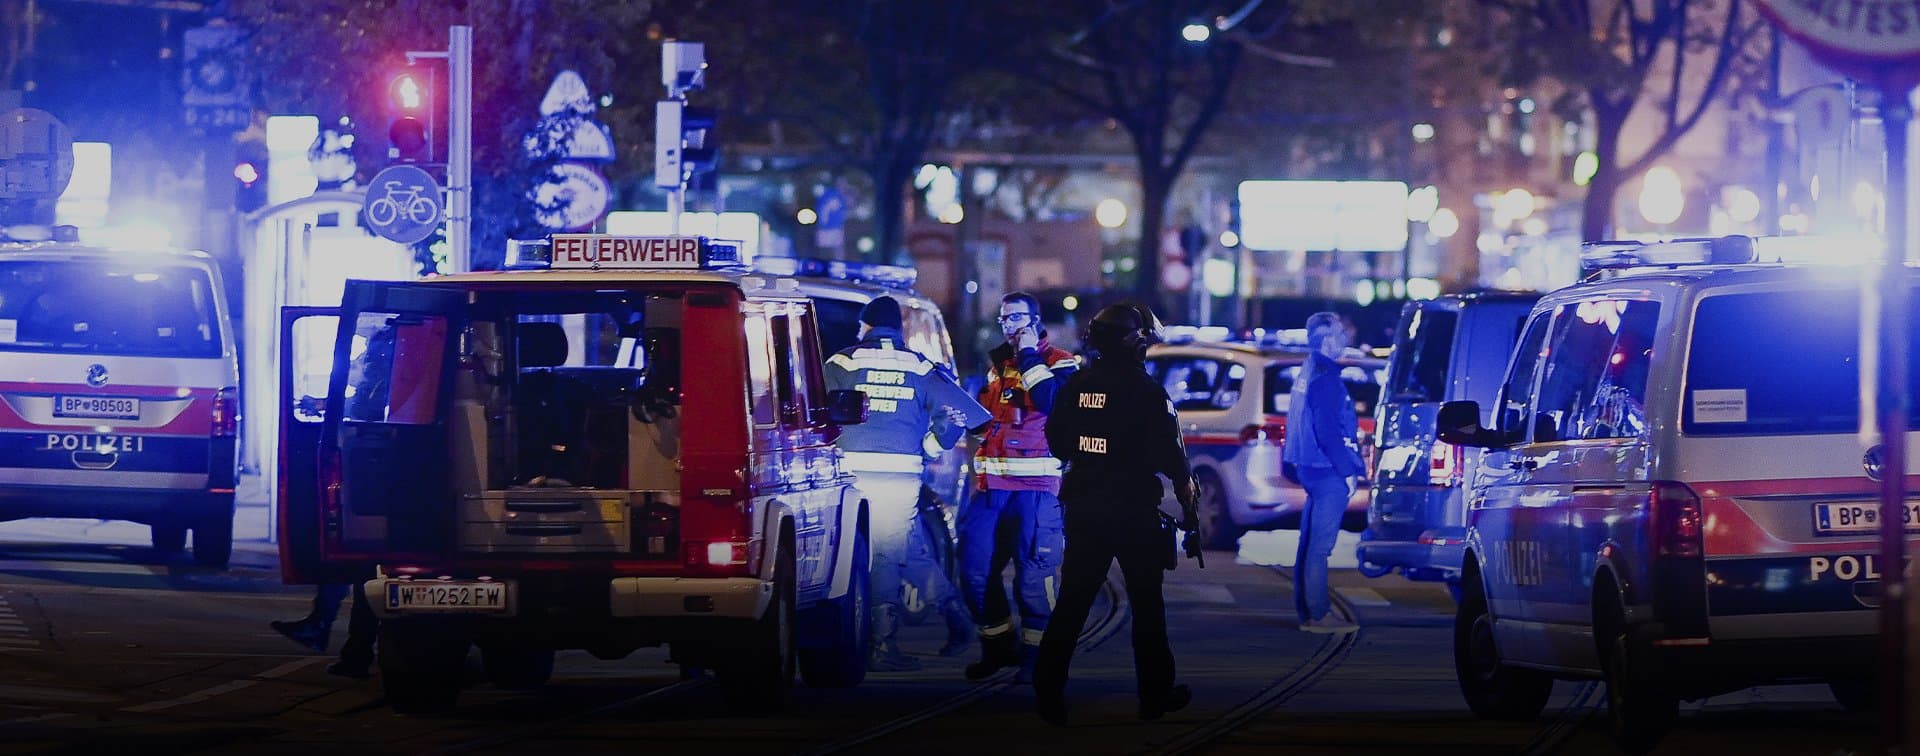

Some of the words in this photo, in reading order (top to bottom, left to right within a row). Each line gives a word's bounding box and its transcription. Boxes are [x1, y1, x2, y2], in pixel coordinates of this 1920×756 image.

[554, 239, 697, 262] FEUERWEHR
[66, 399, 81, 410] BP
[91, 399, 133, 413] 90503
[1079, 392, 1107, 409] POLIZEI
[47, 433, 144, 453] POLIZEI
[1079, 435, 1107, 454] POLIZEI
[1839, 507, 1862, 526] BP
[1494, 540, 1543, 586] POLIZEI
[401, 587, 414, 605] W
[429, 587, 470, 605] 1252
